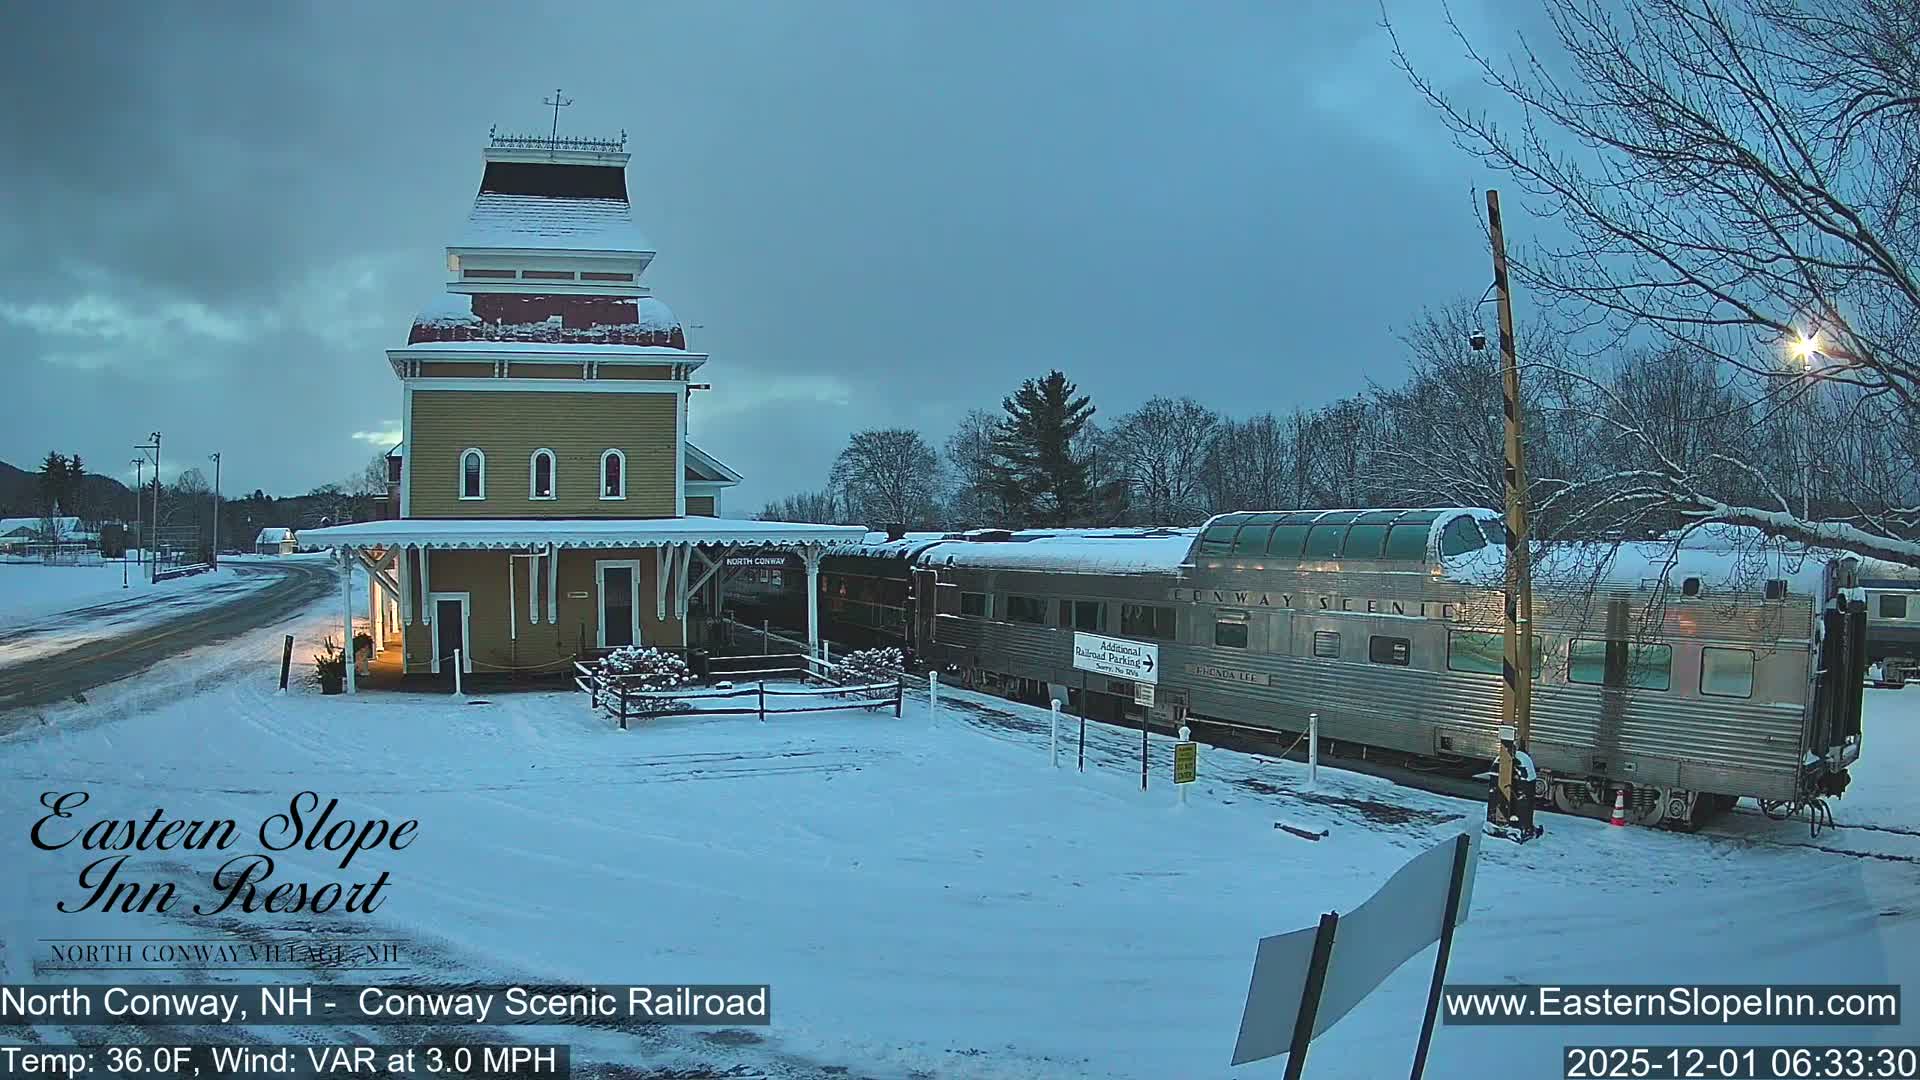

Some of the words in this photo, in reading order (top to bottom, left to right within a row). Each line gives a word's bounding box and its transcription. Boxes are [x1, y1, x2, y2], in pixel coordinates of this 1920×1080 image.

[726, 557, 753, 566] NORTH
[754, 557, 785, 565] CONWAY
[1174, 588, 1294, 608] CONWAY
[1318, 597, 1454, 618] SCENIC
[1101, 641, 1141, 656] Additional
[1076, 646, 1106, 660] Railroad
[1109, 653, 1141, 669] Parking
[1115, 666, 1125, 675] No
